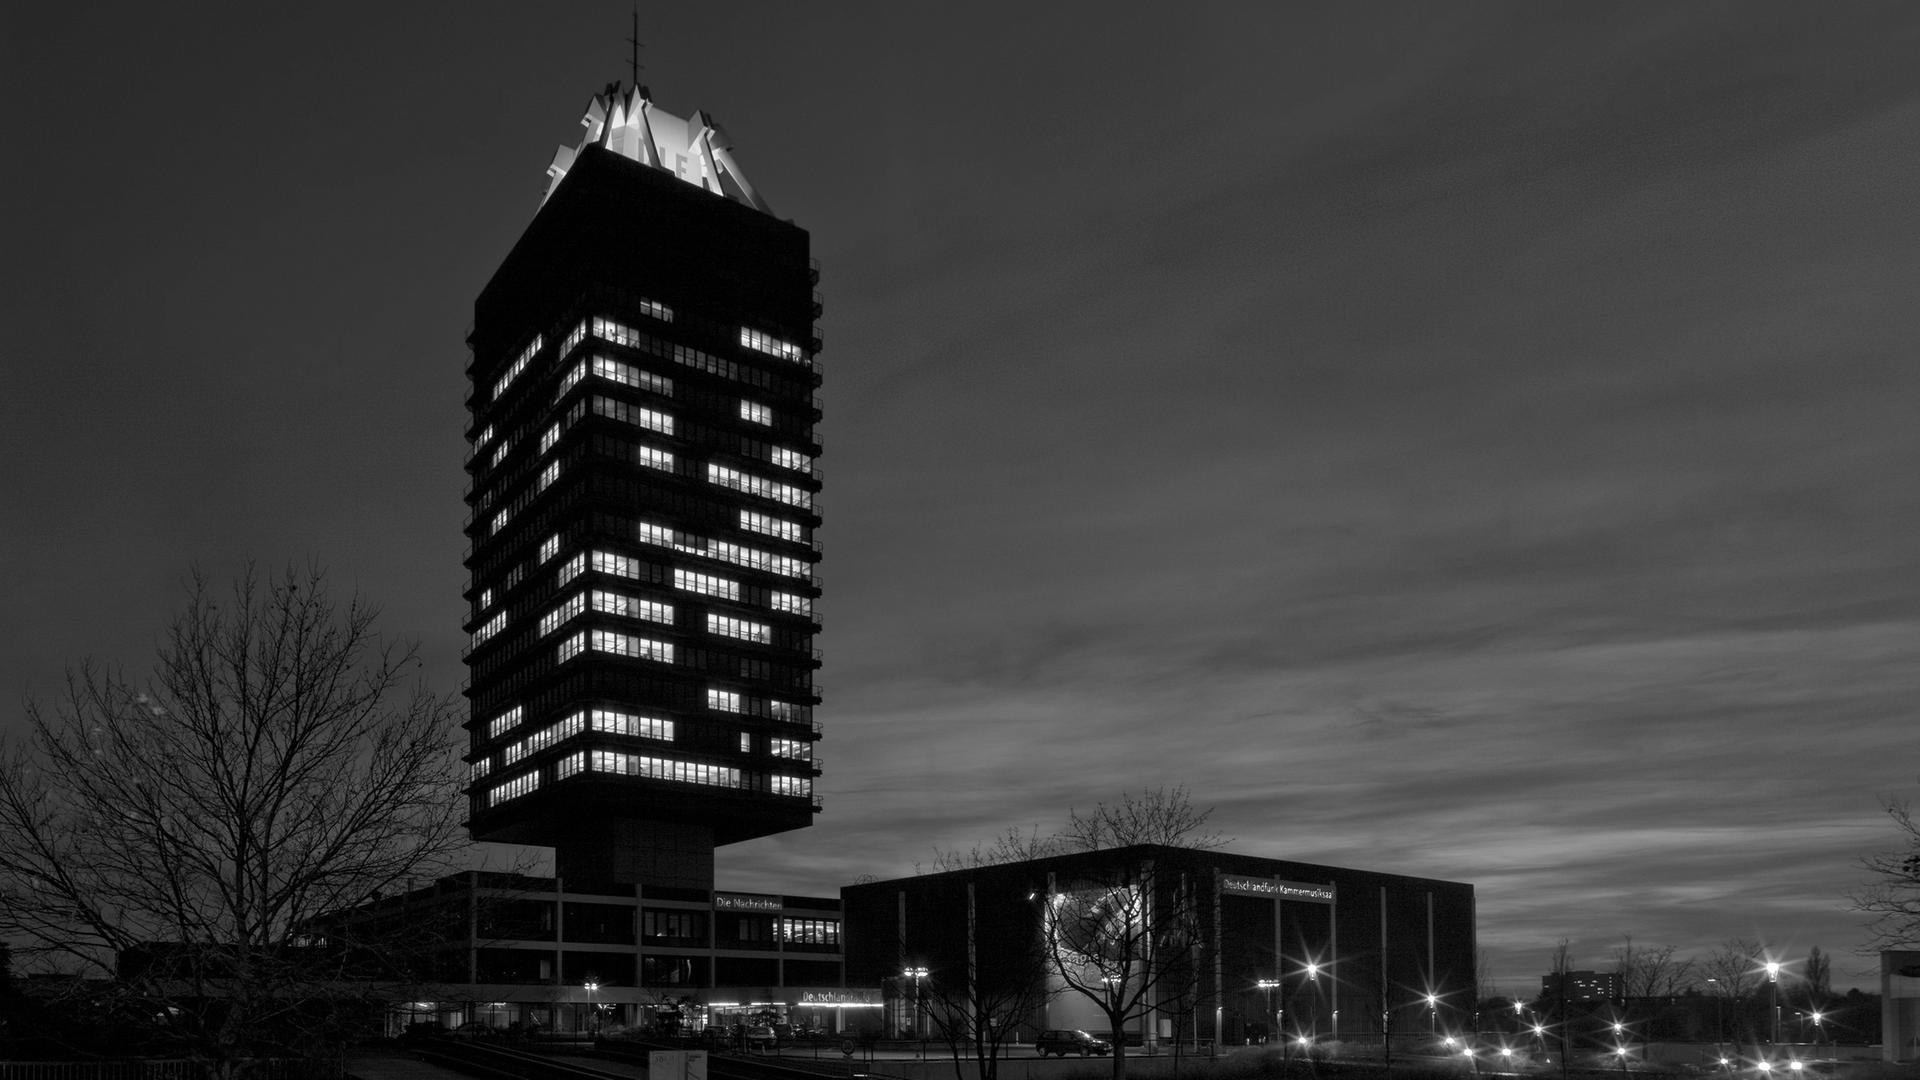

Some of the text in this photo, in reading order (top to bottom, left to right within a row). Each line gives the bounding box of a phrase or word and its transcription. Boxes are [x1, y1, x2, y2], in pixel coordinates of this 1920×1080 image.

[1223, 879, 1278, 893] Deutschandfunk
[716, 897, 783, 911] Die Nachrichten
